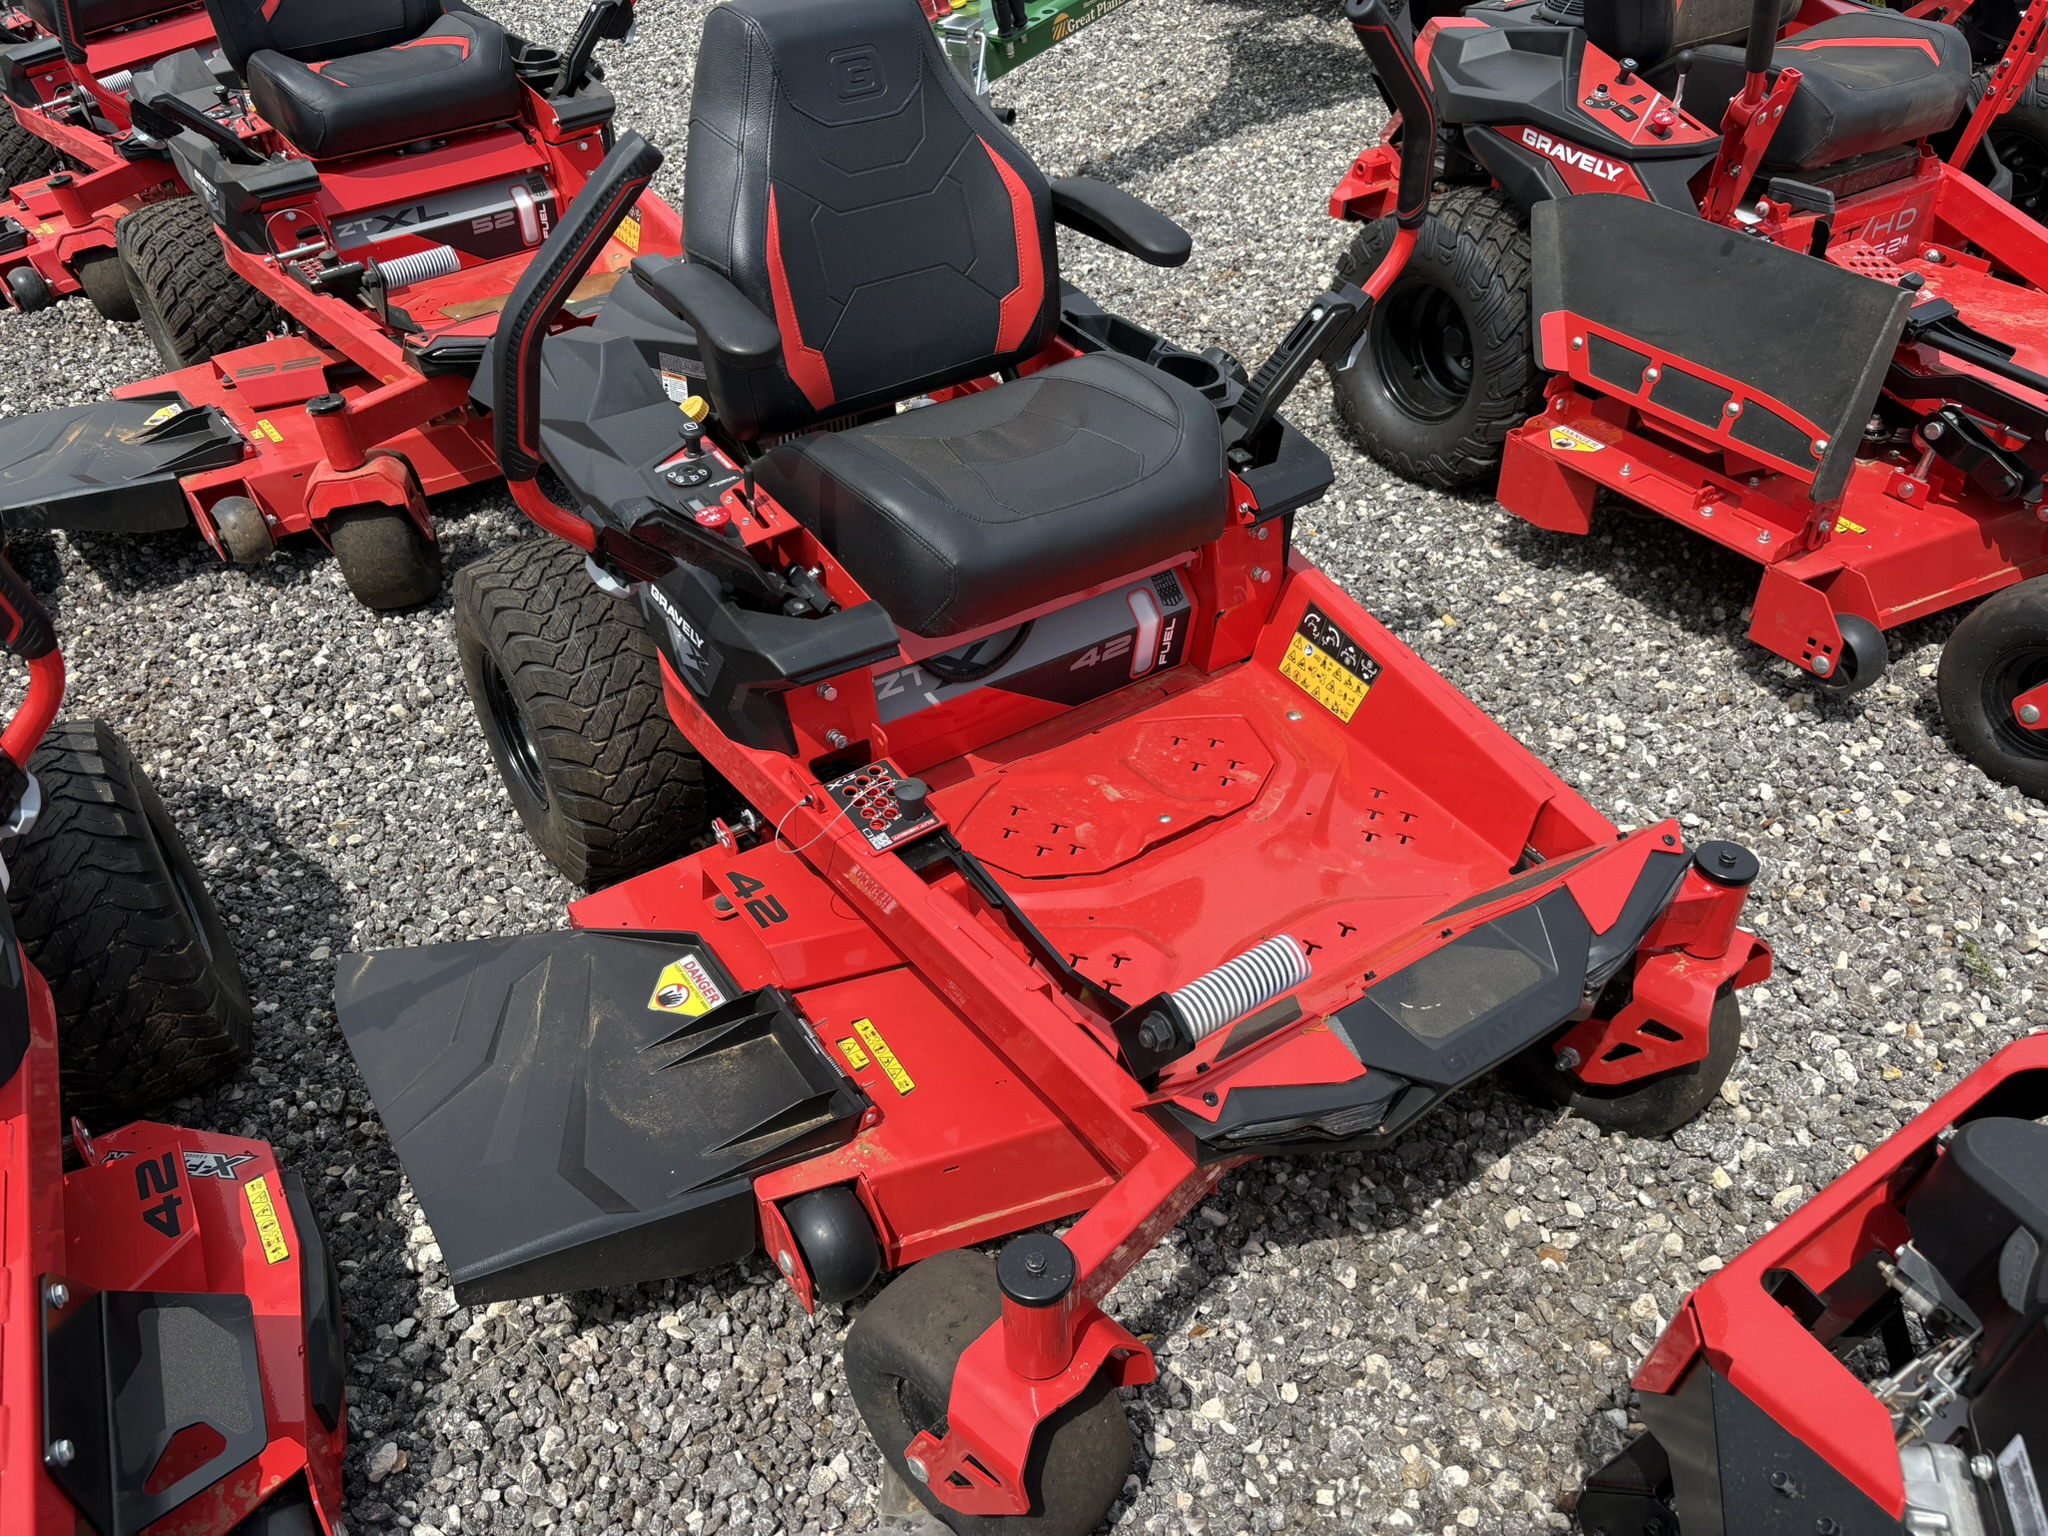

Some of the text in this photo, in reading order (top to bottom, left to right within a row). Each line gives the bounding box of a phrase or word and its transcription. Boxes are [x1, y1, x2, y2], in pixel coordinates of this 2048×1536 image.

[1067, 8, 1096, 33] Great
[1522, 127, 1625, 182] GRAVELY
[335, 205, 449, 239] ZT XL
[471, 211, 516, 235] 52
[538, 203, 551, 239] FUEL
[1561, 427, 1599, 448] DANGER
[650, 584, 705, 649] GRAVELY
[1069, 634, 1132, 672] 42
[1158, 617, 1177, 665] FUEL
[873, 666, 924, 701] ZT
[725, 871, 790, 930] 42
[683, 960, 721, 1005] DANGER
[134, 1151, 183, 1239] 42
